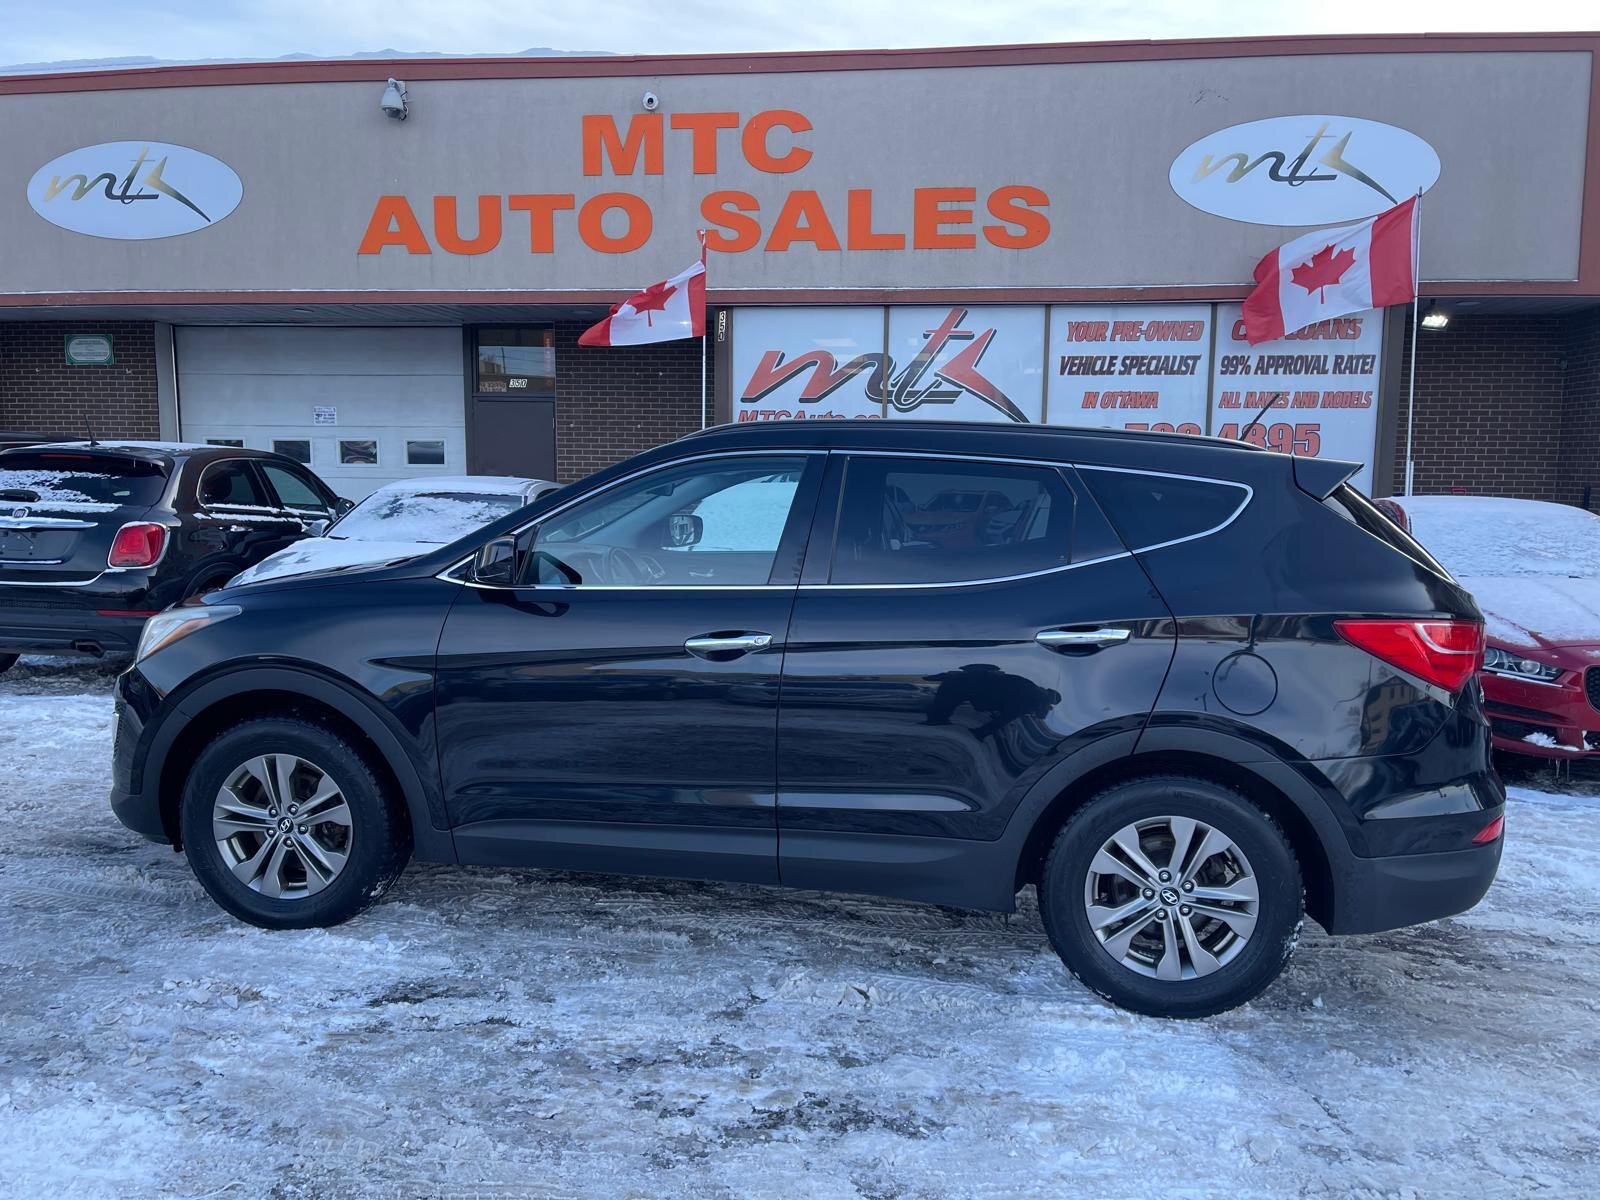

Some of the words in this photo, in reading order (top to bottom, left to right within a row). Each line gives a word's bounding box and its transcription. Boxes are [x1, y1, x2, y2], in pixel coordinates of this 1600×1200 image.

[582, 110, 814, 176] MTC
[358, 192, 654, 256] AUTO
[697, 185, 1051, 253] SALES
[1067, 321, 1110, 342] YOUR
[1110, 321, 1205, 342] PRE-OWNED
[1285, 318, 1363, 340] OANS
[1060, 355, 1118, 376] VEHICLE
[1118, 354, 1202, 376] SPECIALIST
[1220, 355, 1251, 375] 99%
[1254, 354, 1329, 375] APPROVAL
[1332, 354, 1376, 375] RATE!
[1081, 391, 1100, 409] IN
[1100, 391, 1159, 409] OTTAWA
[1218, 391, 1241, 408] ALL
[1243, 391, 1290, 408] MAKES
[1290, 391, 1320, 408] AND
[1320, 391, 1373, 408] MODELS
